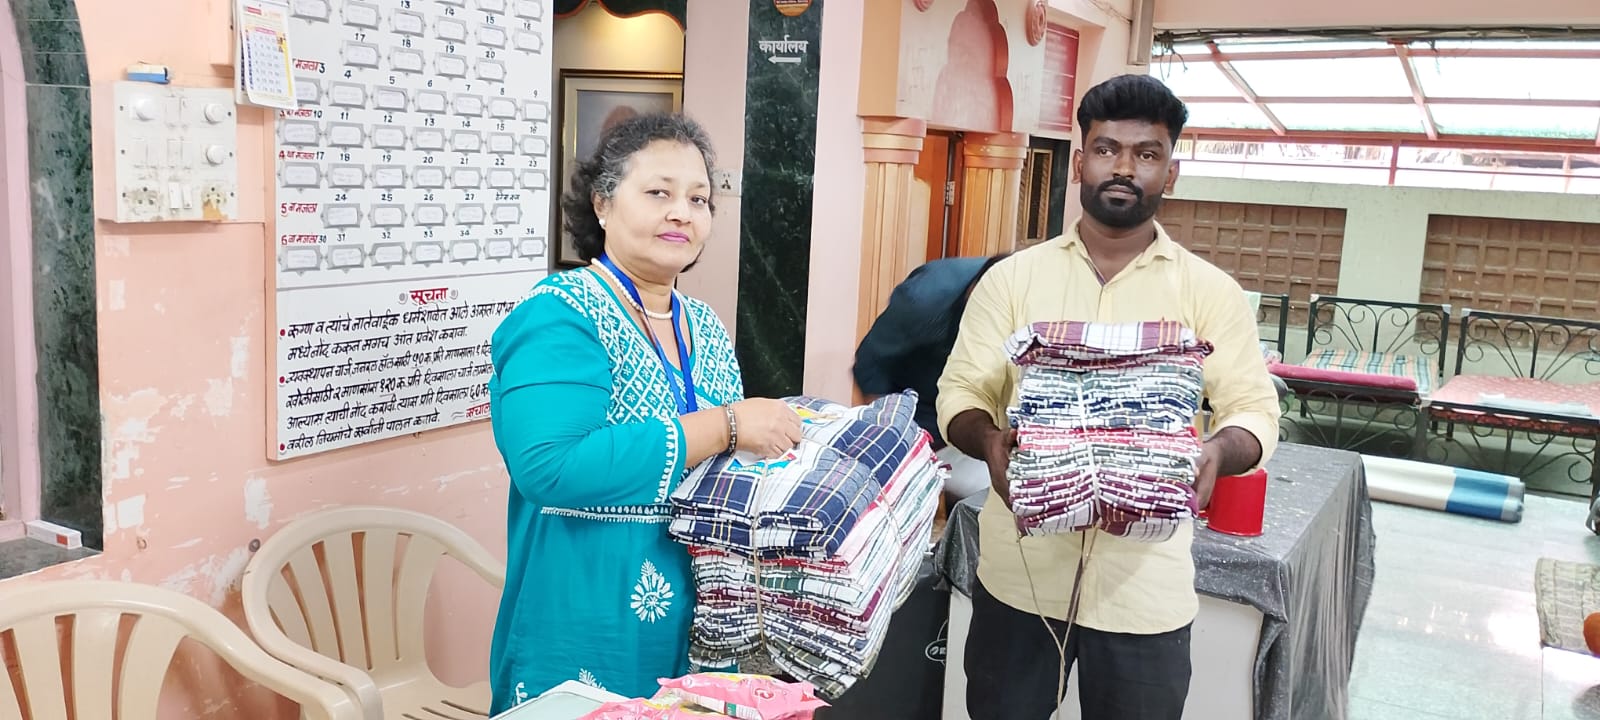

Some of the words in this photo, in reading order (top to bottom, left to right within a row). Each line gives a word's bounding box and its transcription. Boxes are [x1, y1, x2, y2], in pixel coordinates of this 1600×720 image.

[400, 0, 410, 9] 13
[445, 8, 455, 16] 14
[486, 16, 495, 24] 15
[355, 33, 366, 42] 17
[402, 39, 412, 48] 18
[445, 45, 455, 53] 19
[758, 34, 809, 54] कार्यालय
[318, 62, 326, 74] 3
[344, 70, 352, 79] 4
[389, 76, 396, 84] 5
[313, 110, 323, 119] 10
[340, 112, 349, 120] 11
[383, 115, 393, 123] 12
[424, 118, 435, 126] 13
[497, 123, 505, 131] 15
[316, 152, 325, 160] 17
[340, 153, 350, 161] 18
[423, 156, 434, 164] 20
[495, 158, 505, 166] 22
[281, 203, 287, 214] 5
[381, 194, 393, 202] 25
[282, 235, 288, 245] 6
[409, 288, 449, 304] सूचना
[315, 321, 326, 334] व
[326, 312, 352, 334] त्यांचे
[352, 309, 400, 331] नातेवाईक
[403, 304, 448, 324] धर्मशाळेत
[449, 300, 469, 320] आले
[288, 340, 311, 360] मध्ये
[311, 338, 331, 358] नोंद
[362, 336, 391, 351] मगच
[415, 326, 438, 344] प्रवेश
[286, 365, 335, 384] व्यवस्थापन
[352, 360, 378, 376] जनरल
[481, 340, 492, 357] दिव
[286, 383, 334, 408] खोलीसाठी
[333, 386, 341, 401] २
[380, 377, 396, 394] १२०
[407, 369, 422, 386] प्रति
[424, 368, 458, 385] दिवसाला
[458, 361, 474, 377] चार्ज
[287, 413, 325, 429] आल्यास
[325, 401, 350, 424] त्याची
[350, 401, 368, 418] नोंद
[397, 396, 419, 409] त्यास
[420, 387, 435, 405] प्रति
[436, 386, 470, 404] दिवसाला
[469, 384, 481, 399] ६०
[287, 433, 315, 450] वरील
[316, 424, 353, 445] नियमांचे
[386, 417, 413, 432] पालन
